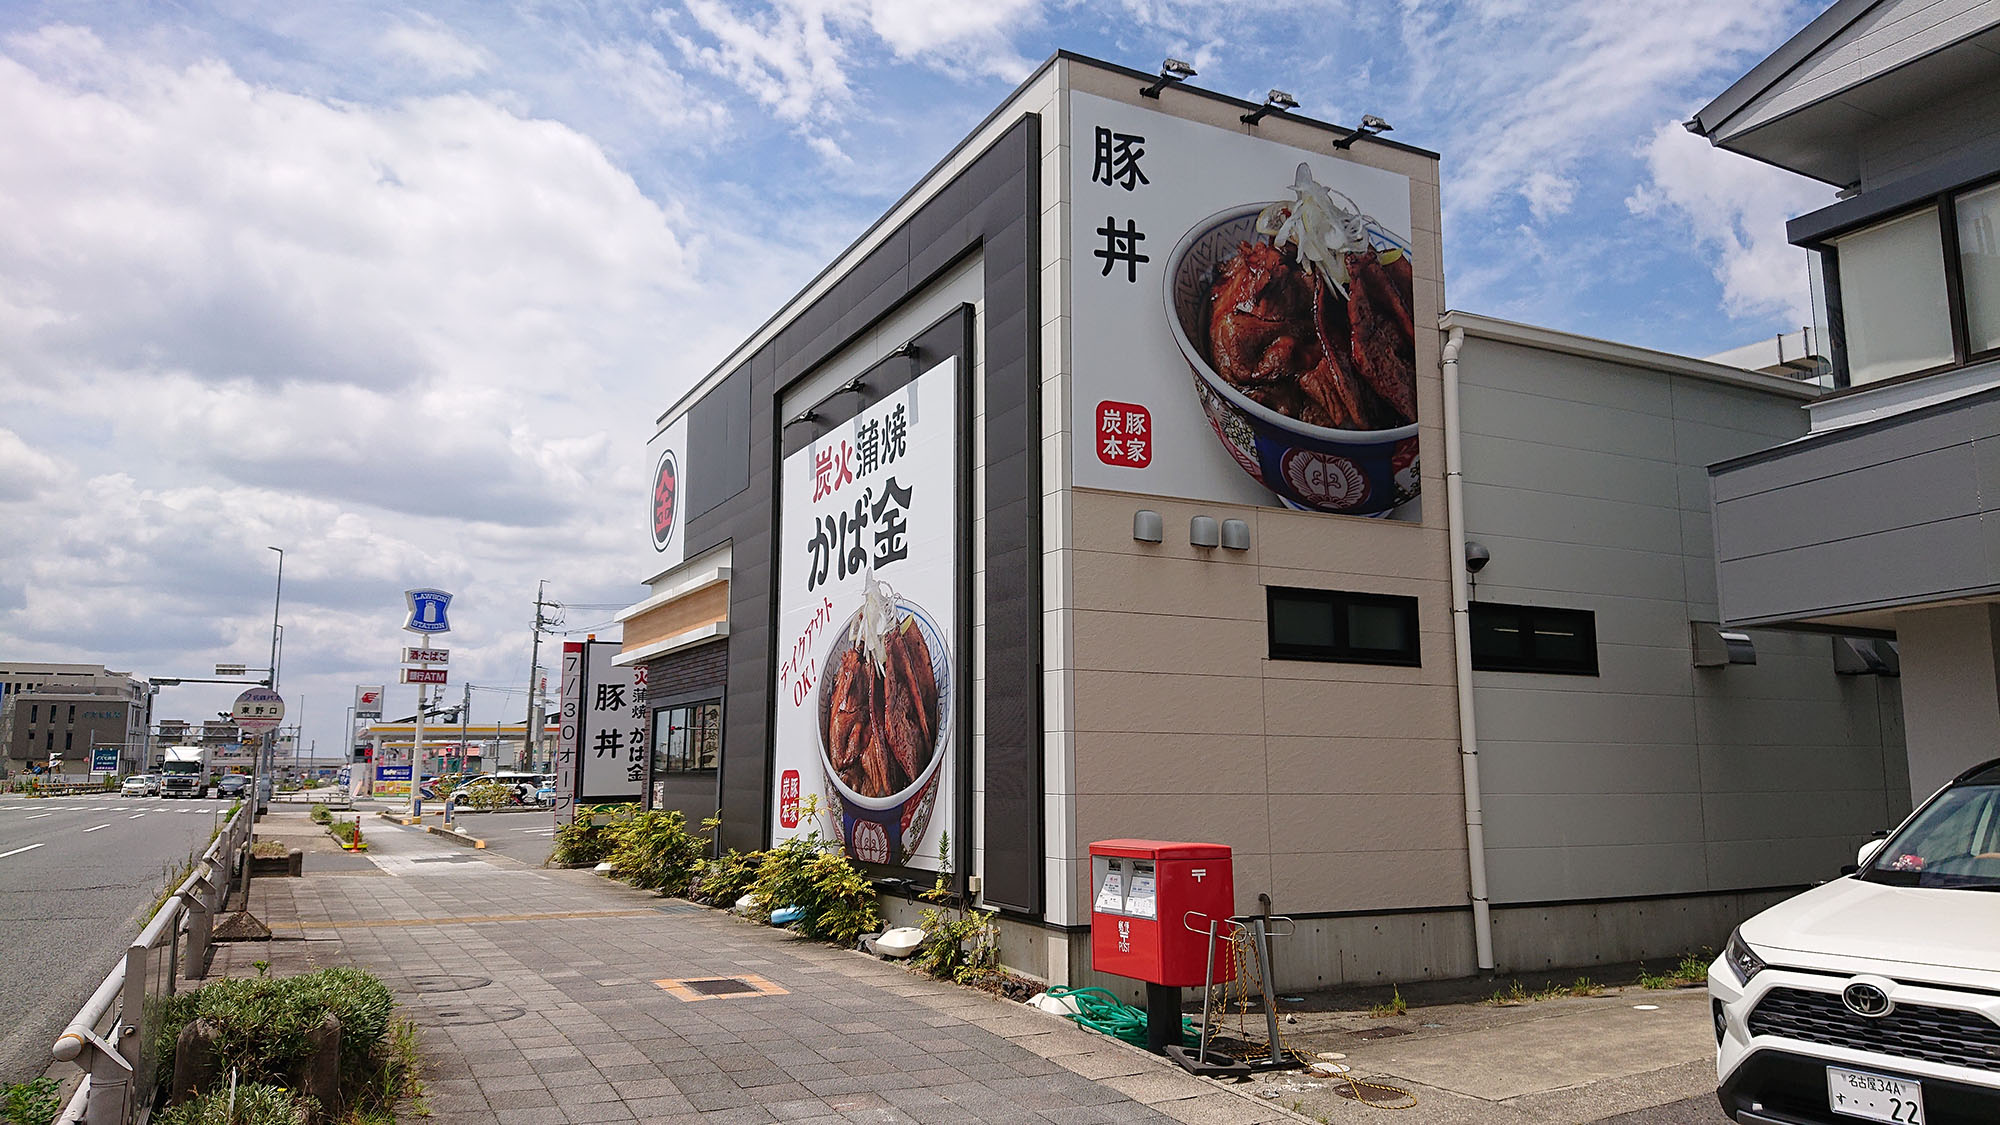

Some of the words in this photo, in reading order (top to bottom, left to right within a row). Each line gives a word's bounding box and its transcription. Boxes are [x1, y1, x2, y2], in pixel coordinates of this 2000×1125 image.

[1091, 125, 1150, 284] 豚丼
[812, 402, 907, 504] 炭火蒲焼
[655, 468, 676, 534] 金
[807, 476, 913, 593] かば金
[411, 619, 446, 629] STATION
[414, 593, 449, 603] LAWSON
[409, 671, 445, 682] 銀行ATM
[631, 664, 649, 719] 火蒲焼
[793, 658, 817, 707] OK!
[240, 706, 278, 715] 東野口
[593, 684, 627, 759] 豚丼
[1118, 942, 1130, 952] POST
